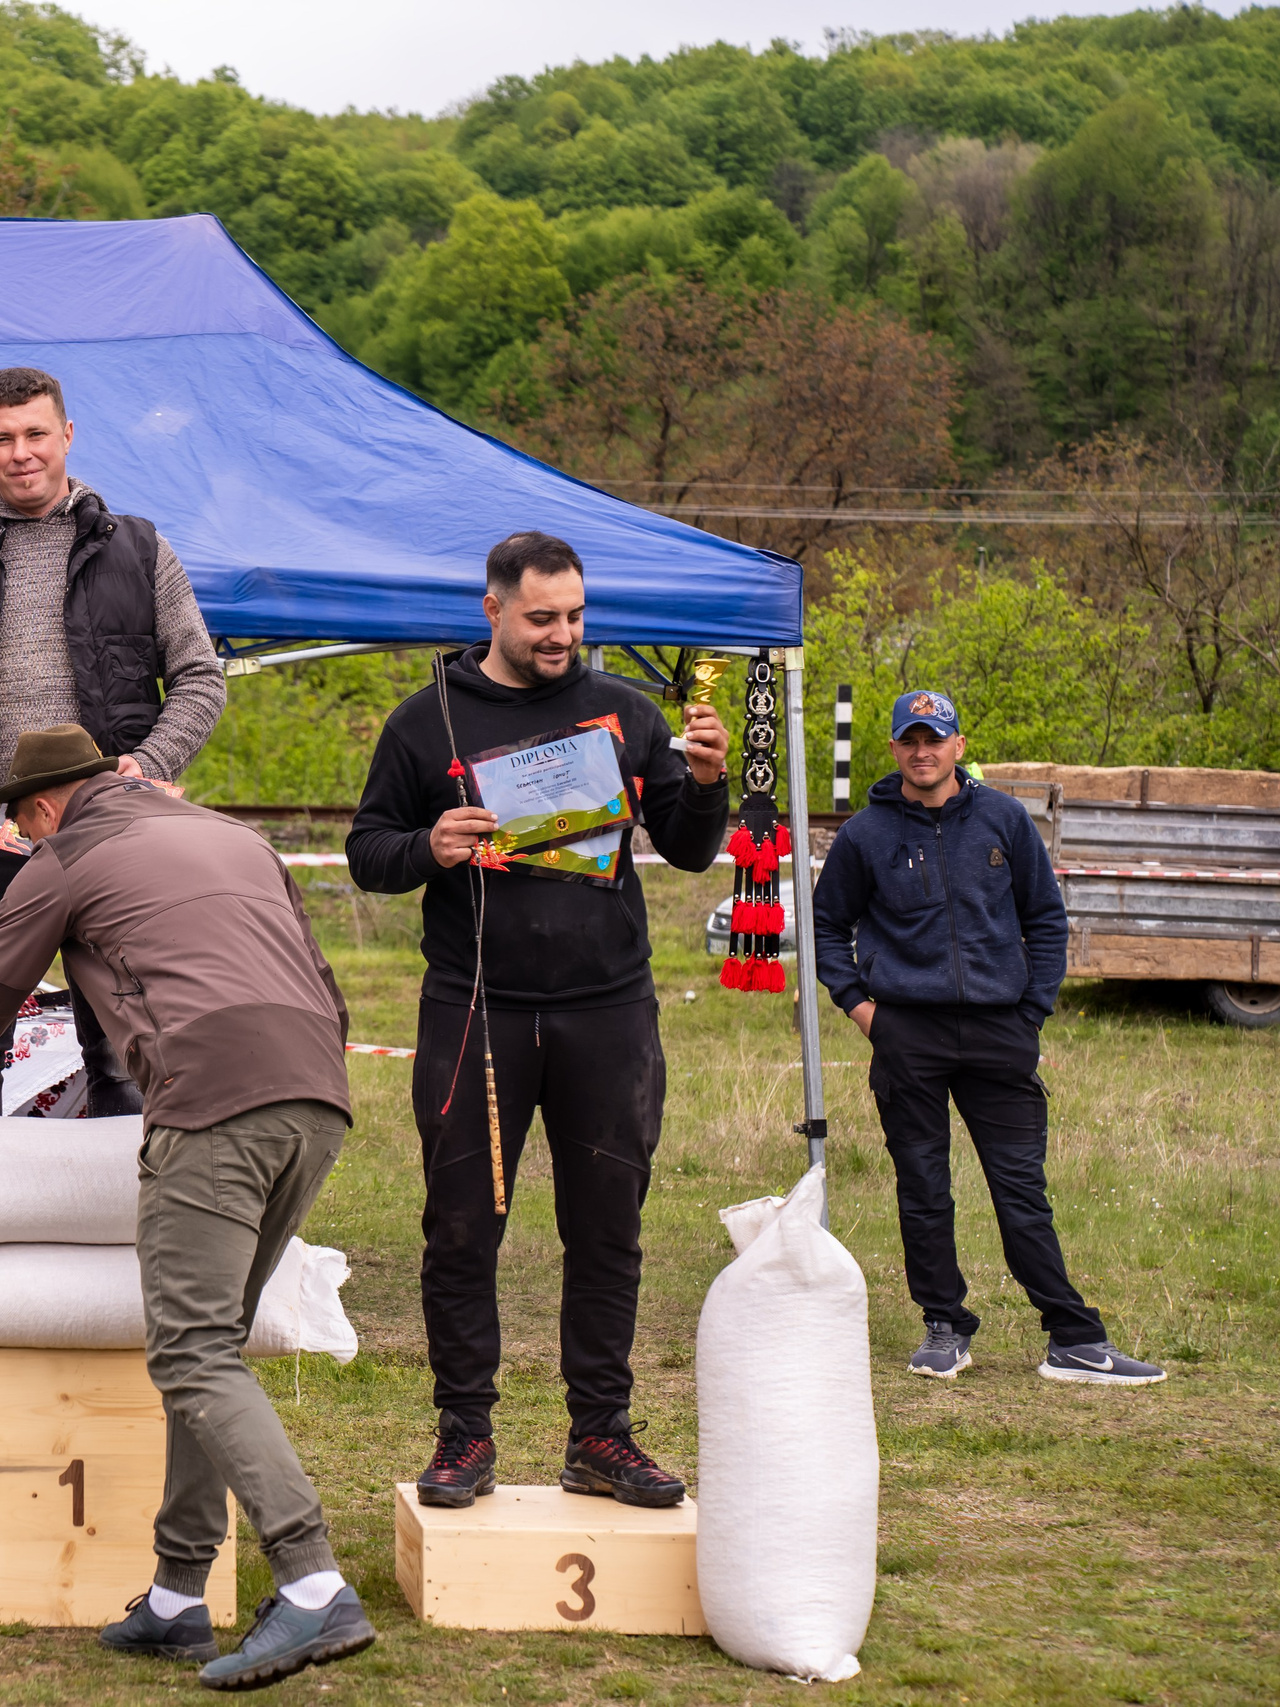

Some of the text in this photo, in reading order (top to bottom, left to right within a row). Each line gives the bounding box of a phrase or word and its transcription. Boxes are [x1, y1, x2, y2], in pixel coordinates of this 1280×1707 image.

[510, 739, 578, 768] DIPLOMĂ
[59, 1459, 84, 1527] 1
[555, 1552, 596, 1622] 3
